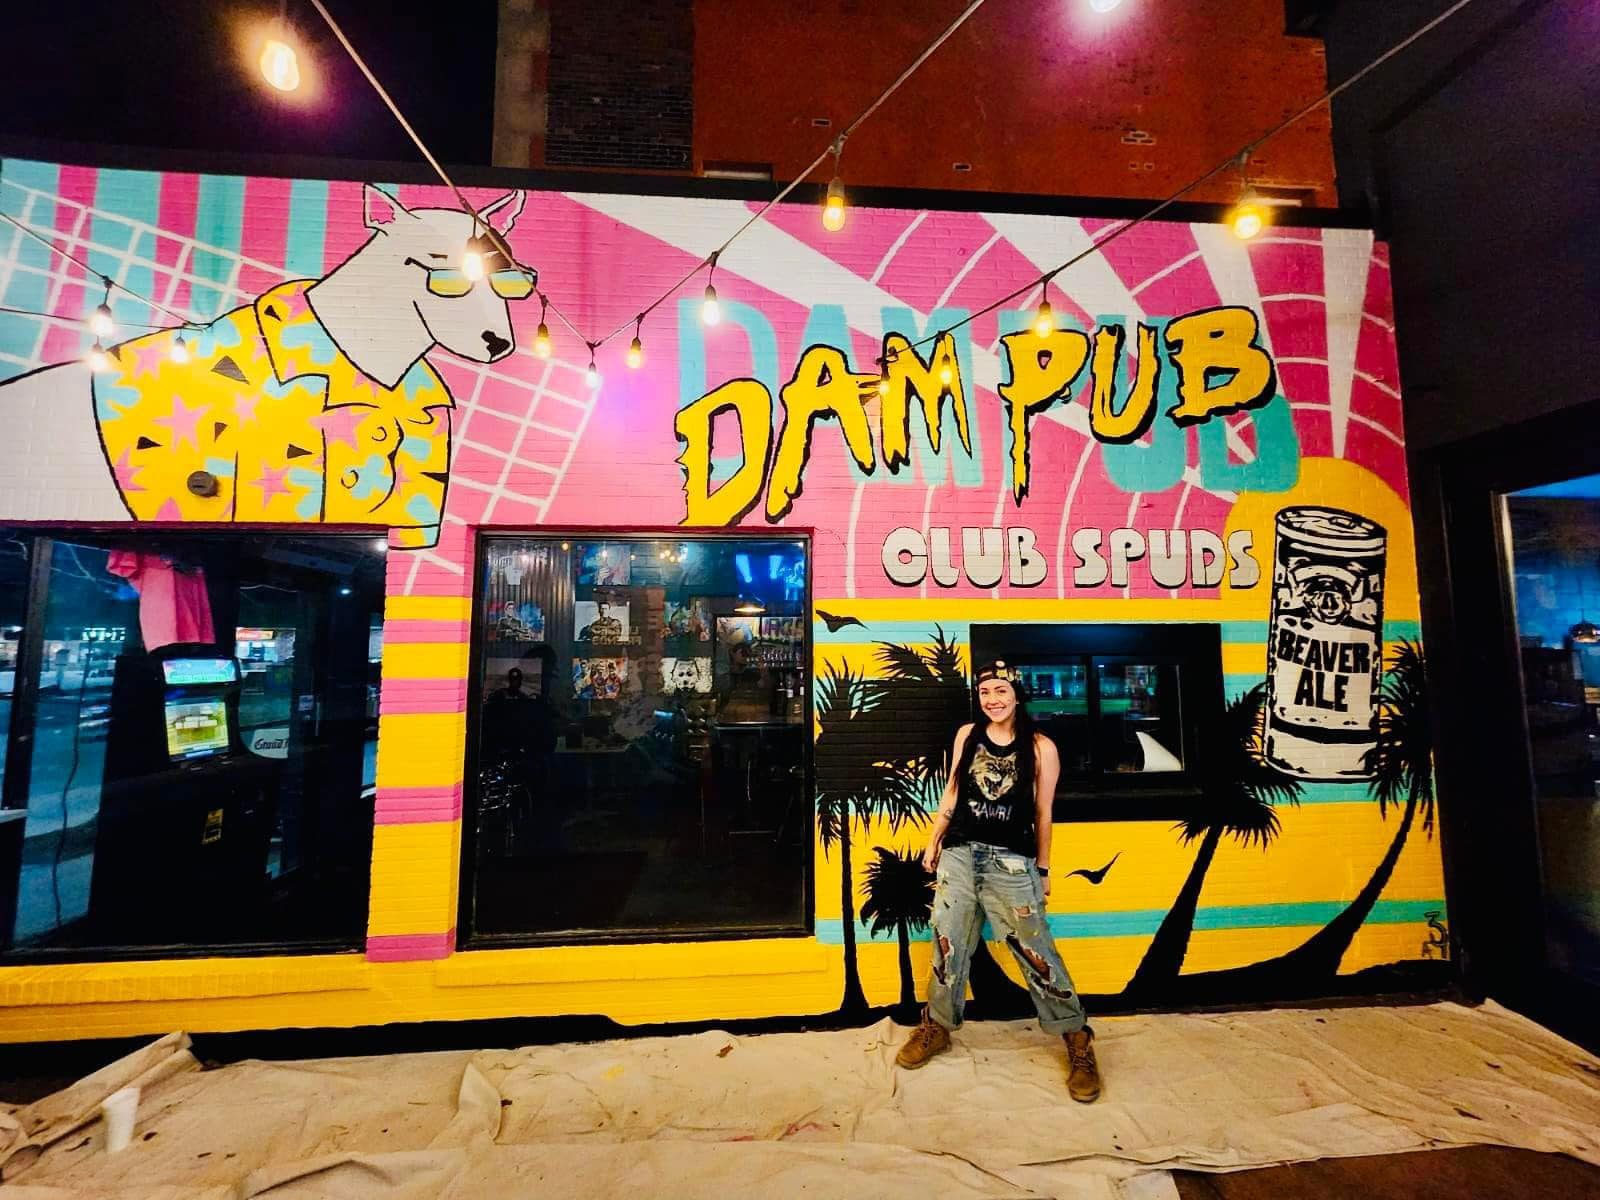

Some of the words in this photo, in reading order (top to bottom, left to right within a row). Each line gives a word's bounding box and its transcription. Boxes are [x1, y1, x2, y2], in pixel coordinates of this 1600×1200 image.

[674, 330, 973, 527] DAM
[997, 305, 1277, 508] PUB
[881, 526, 1048, 588] CLUB
[1071, 527, 1261, 589] SPUDS
[1277, 628, 1370, 674] BEAVER
[1294, 668, 1349, 712] ALE
